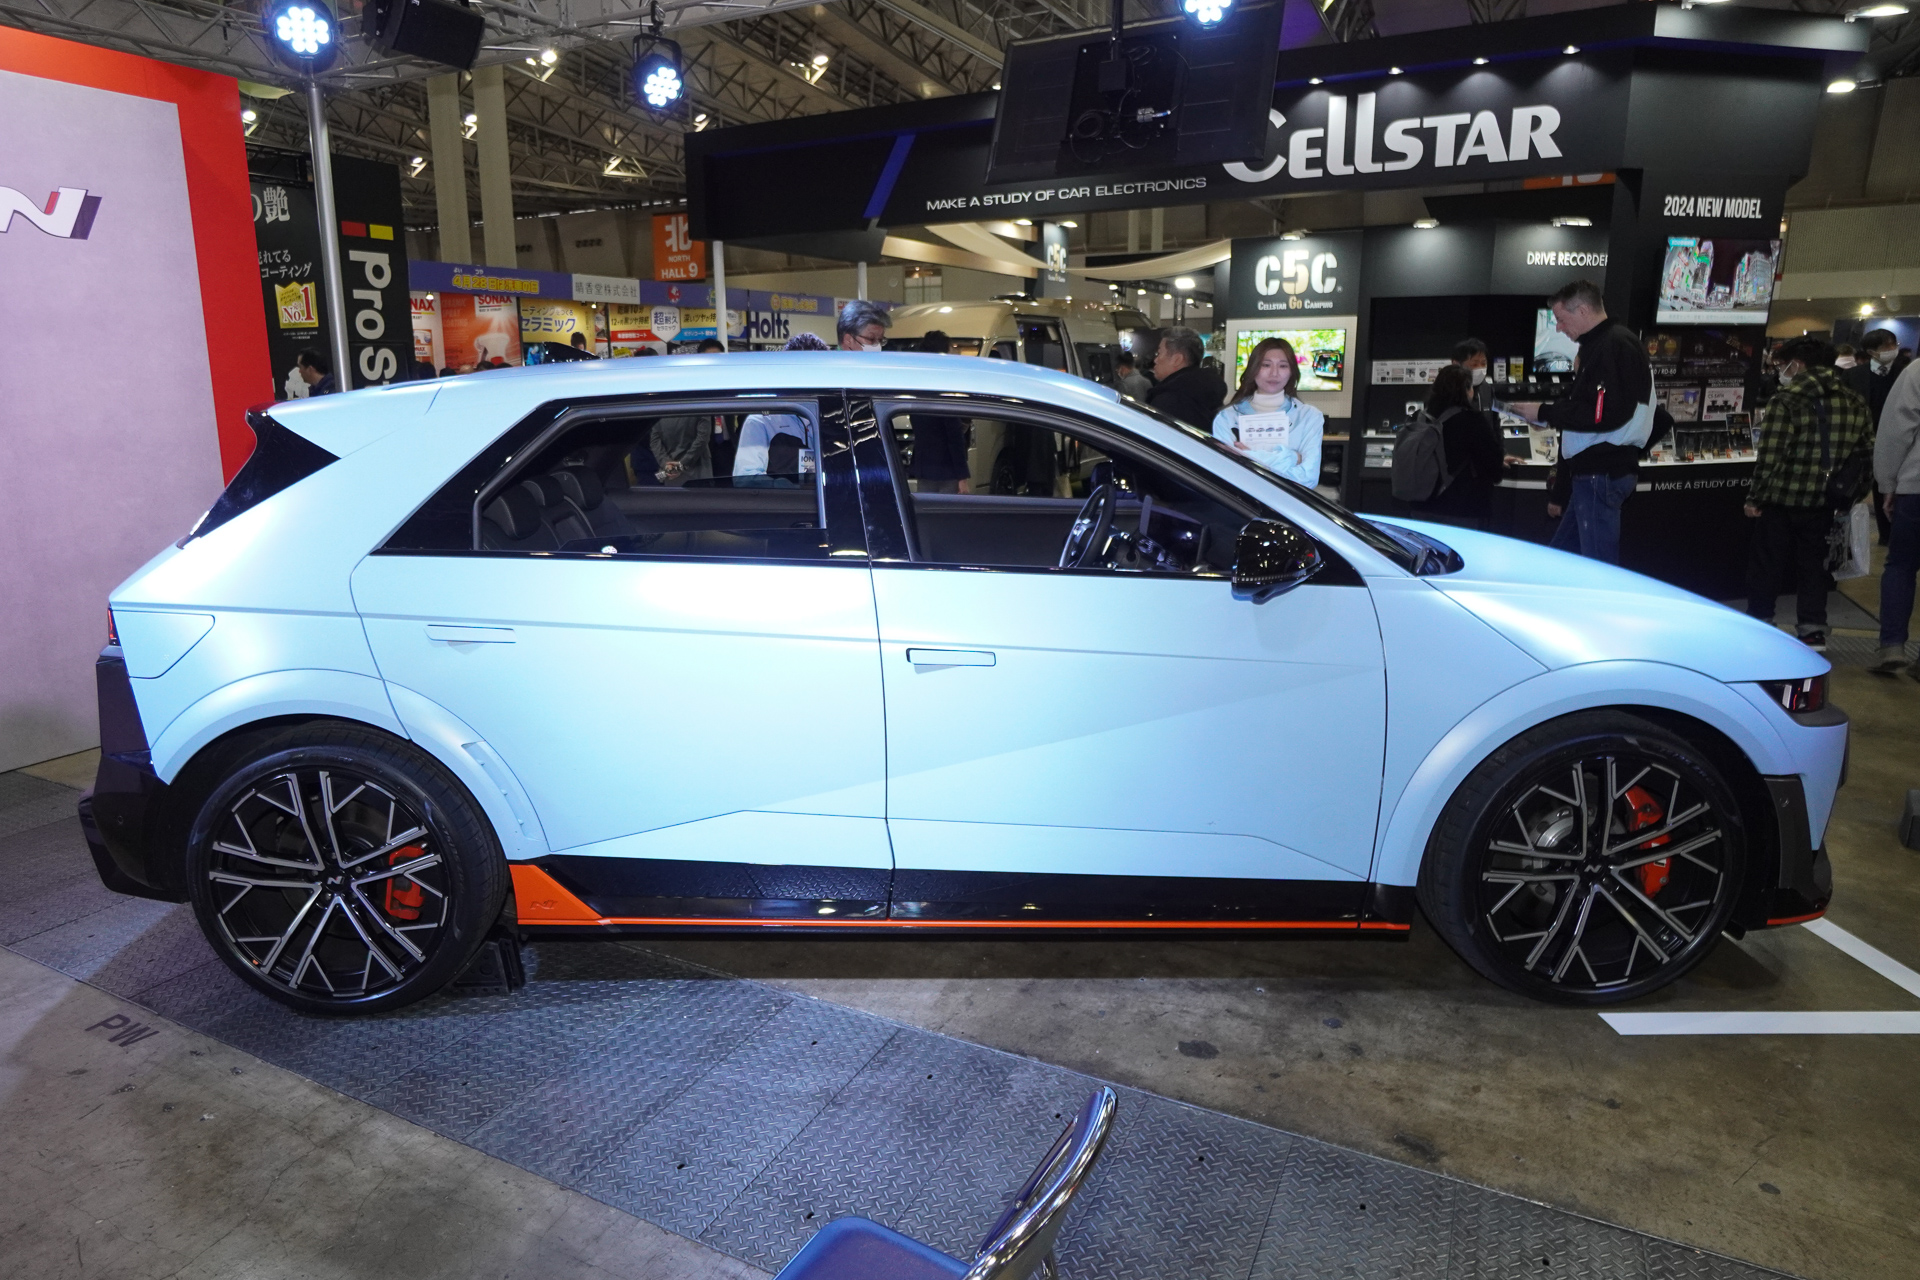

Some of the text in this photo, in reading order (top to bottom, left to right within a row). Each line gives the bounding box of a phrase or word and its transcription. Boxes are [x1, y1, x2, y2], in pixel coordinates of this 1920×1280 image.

[926, 177, 1208, 211] MAKE A STUDY OF CAR ELECTRONICS
[1663, 195, 1762, 219] 2024 NEW MODEL
[665, 216, 692, 252] 北
[1527, 250, 1556, 266] DRIVE
[261, 262, 312, 279] コーティング
[661, 262, 698, 279] HALL 9
[1255, 250, 1338, 295] C5C
[574, 281, 638, 299] 晴香堂株式会社
[282, 285, 315, 323] No.1
[478, 294, 513, 305] SONAX
[521, 317, 576, 333] セラミック
[749, 312, 790, 340] Holts
[1655, 482, 1682, 491] MAKE
[1684, 482, 1691, 490] A
[1693, 480, 1725, 490] STUDY
[1726, 479, 1739, 487] OF
